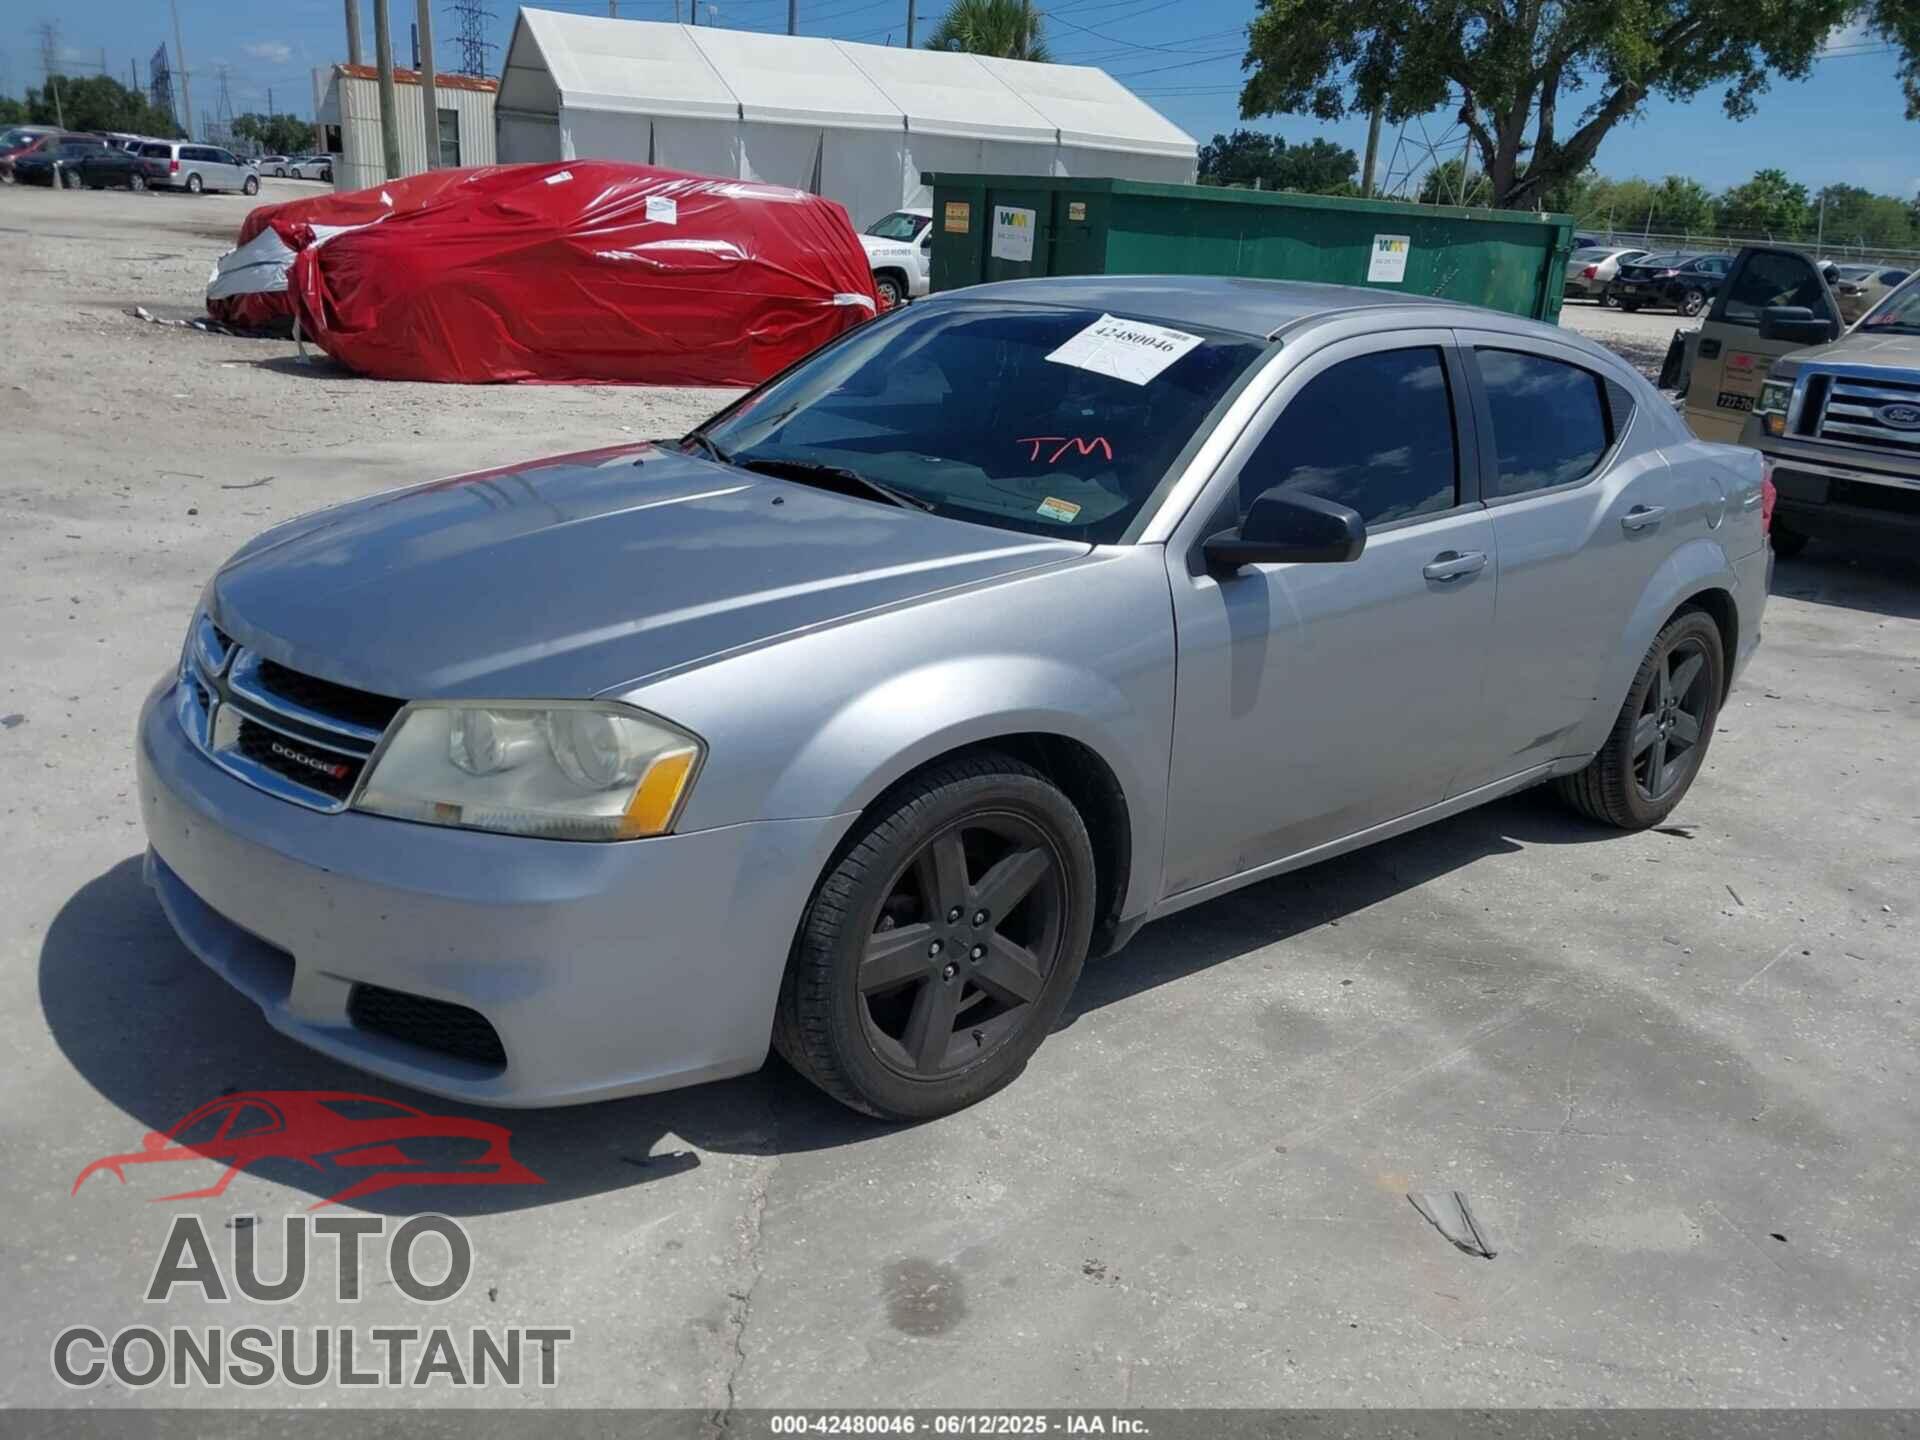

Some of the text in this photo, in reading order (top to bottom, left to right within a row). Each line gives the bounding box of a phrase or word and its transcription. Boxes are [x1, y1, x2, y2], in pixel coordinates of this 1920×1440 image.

[1000, 211, 1027, 226] WM
[1379, 239, 1406, 252] WM
[1095, 326, 1174, 353] 42480046
[1888, 408, 1918, 422] Ford
[1016, 437, 1112, 463] TM
[271, 741, 337, 773] DODGE
